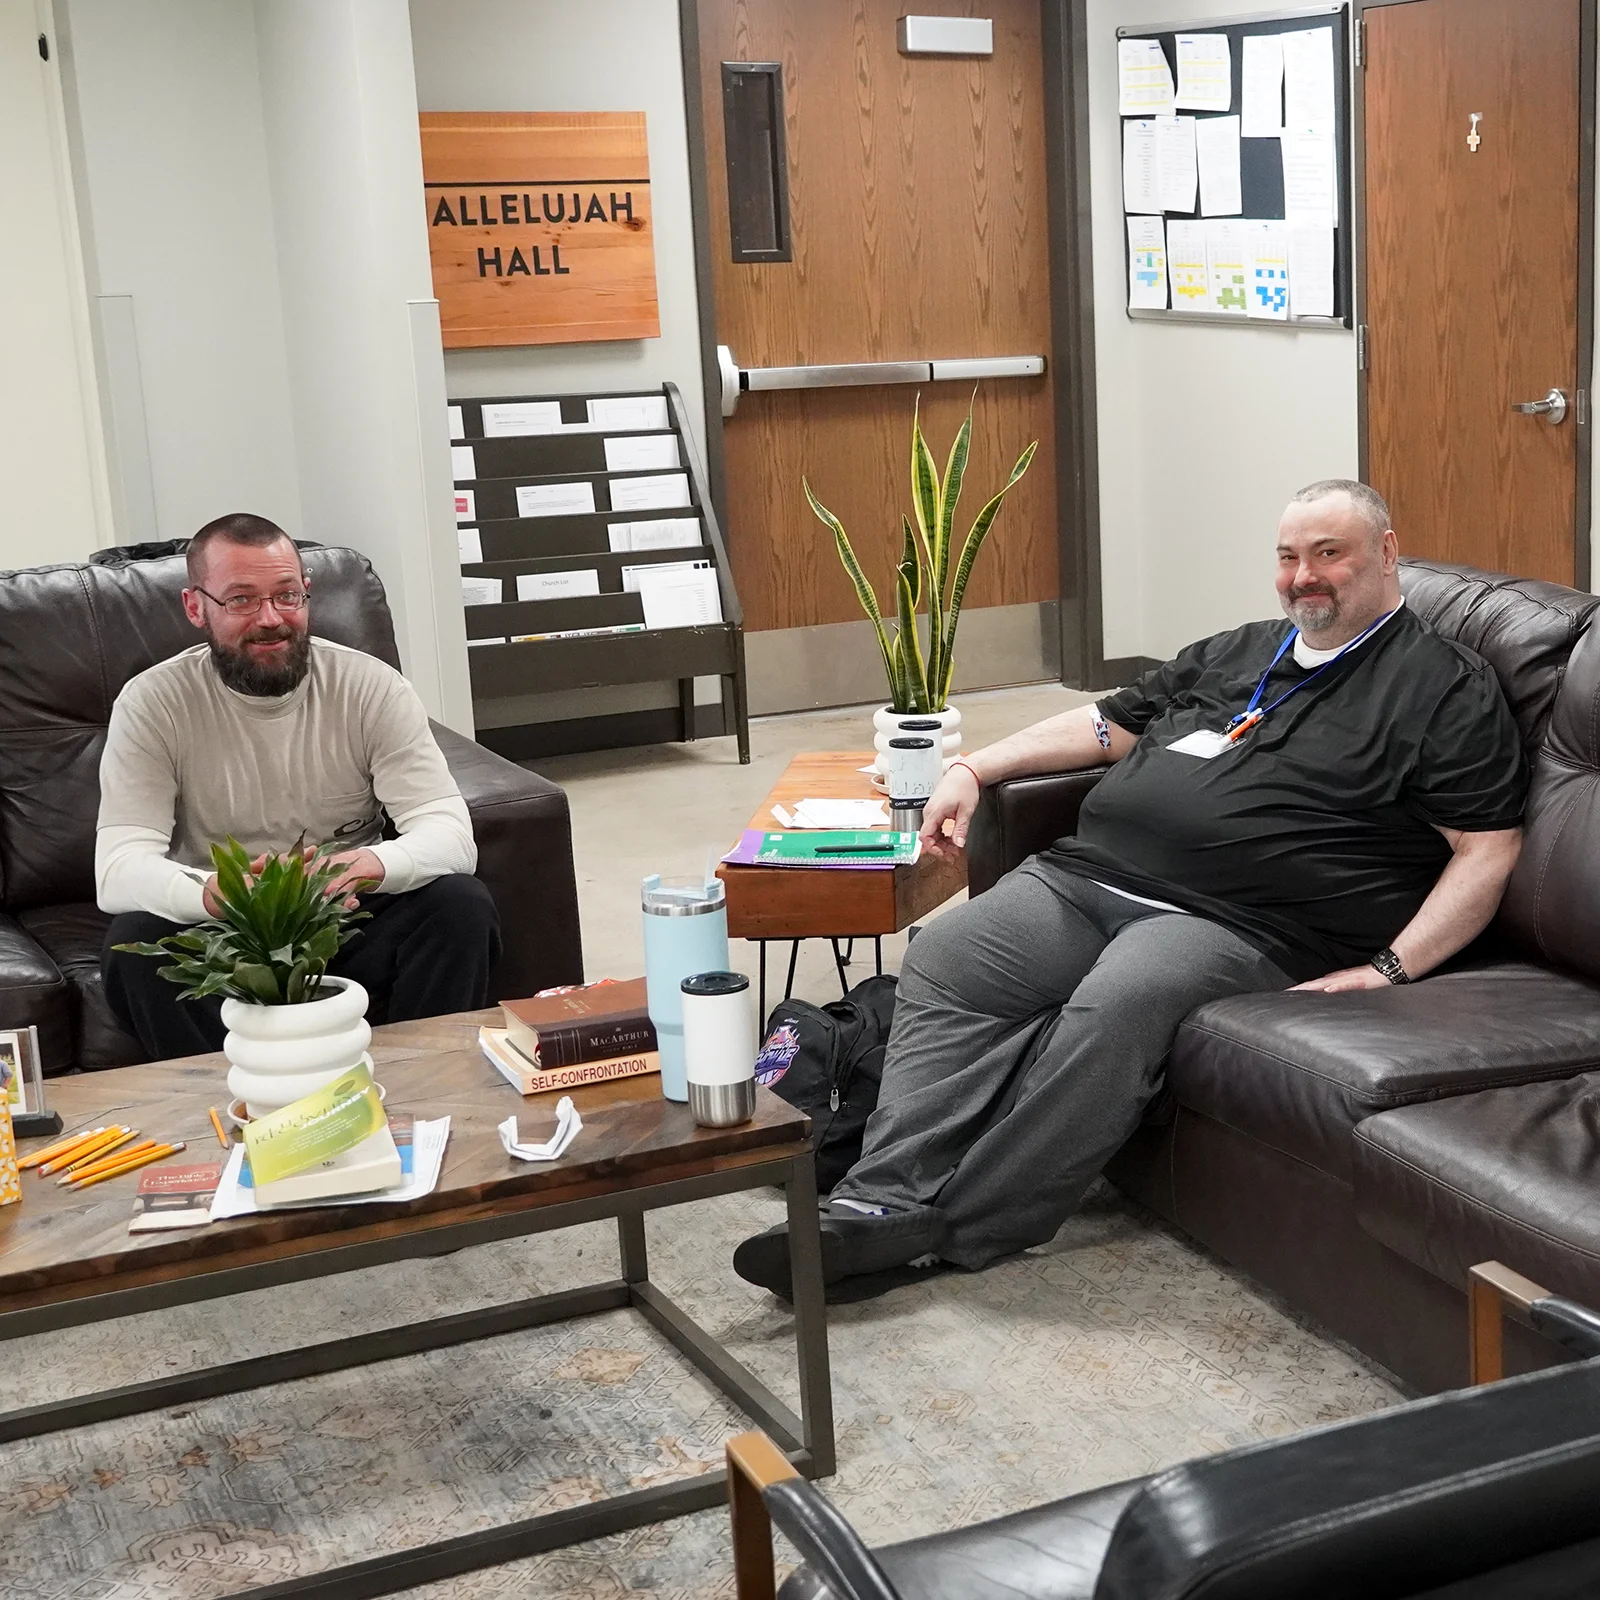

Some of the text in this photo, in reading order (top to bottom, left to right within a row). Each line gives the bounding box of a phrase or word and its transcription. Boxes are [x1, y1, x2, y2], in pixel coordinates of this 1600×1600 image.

[432, 192, 633, 227] ALLELUJAH
[478, 245, 570, 277] HALL
[532, 1059, 647, 1090] SELF-CONFRONTATION
[300, 1086, 370, 1130] JOURNEY
